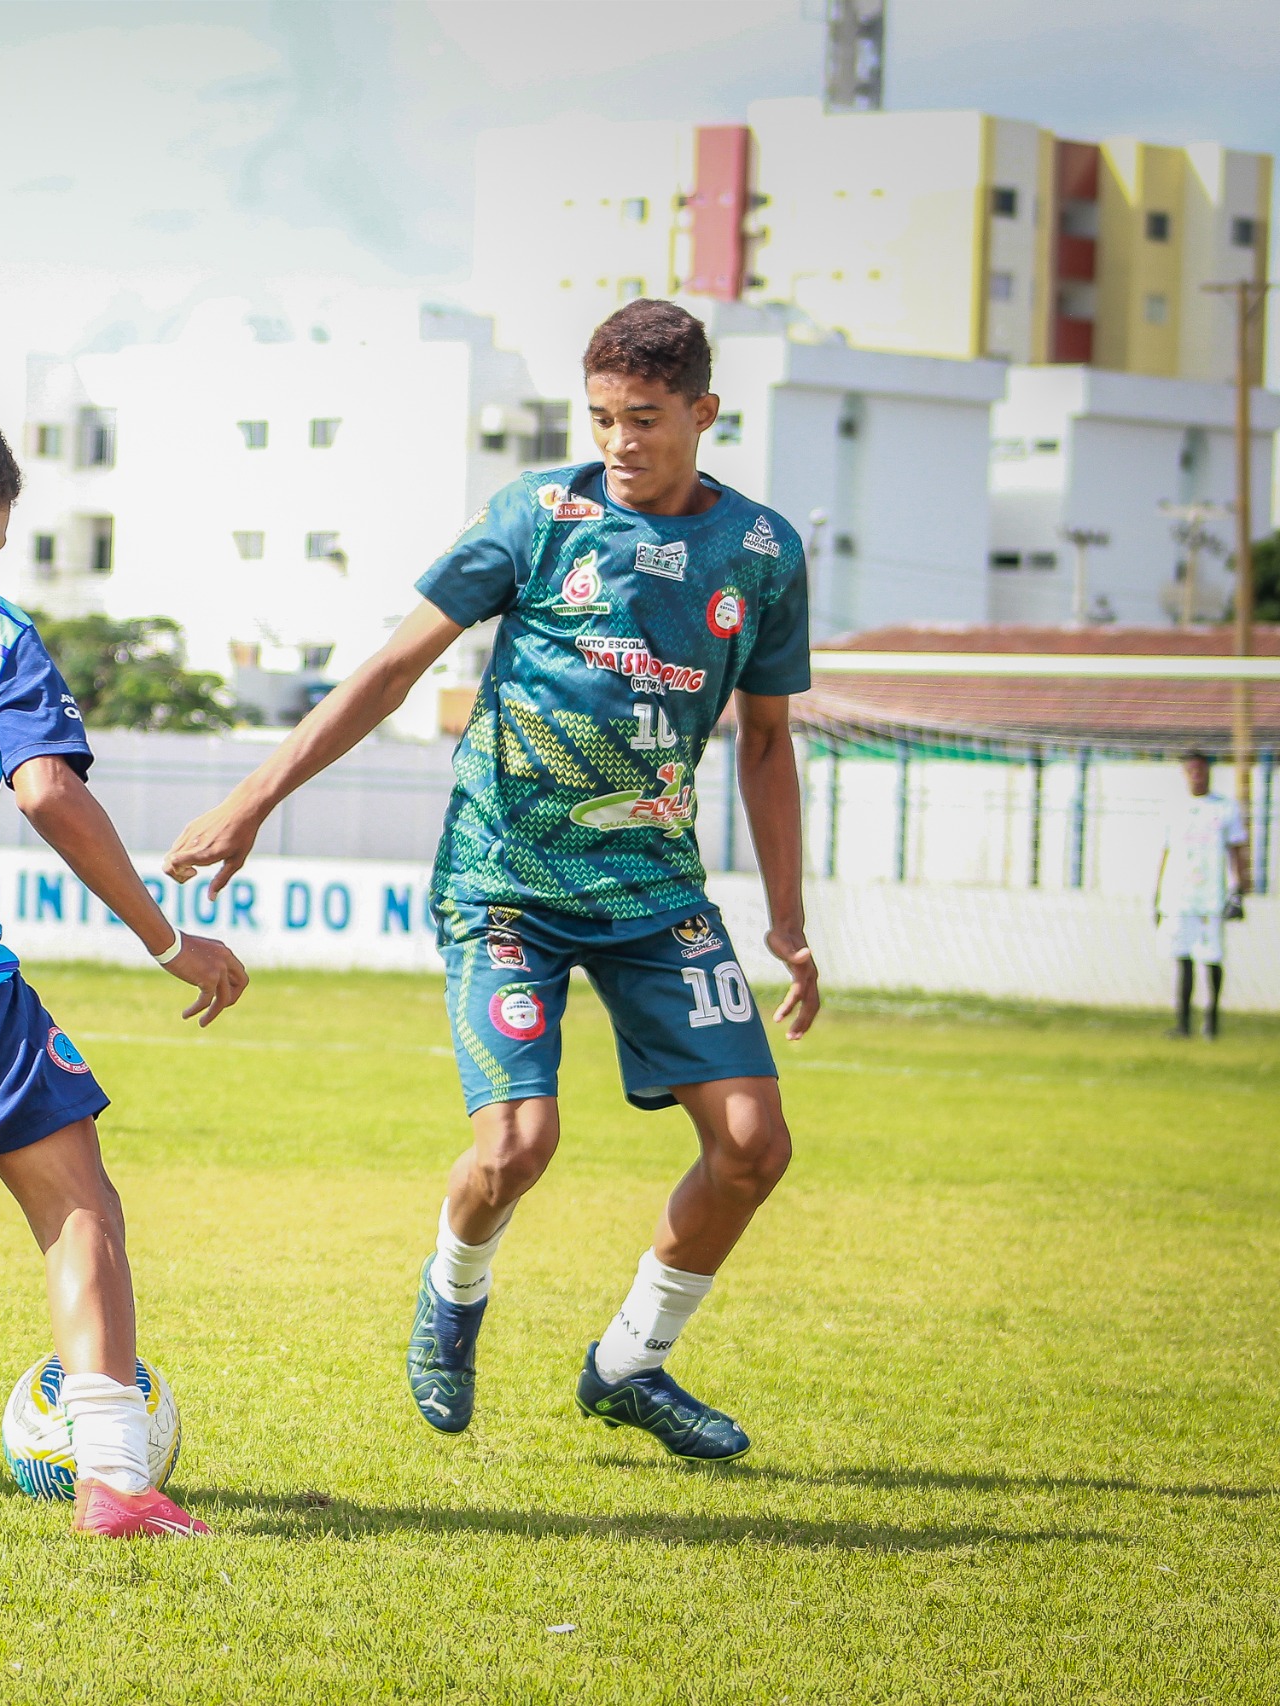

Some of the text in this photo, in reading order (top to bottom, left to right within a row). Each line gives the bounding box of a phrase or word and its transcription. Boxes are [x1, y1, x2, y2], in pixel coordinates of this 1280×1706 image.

[577, 639, 647, 649] AUTO ESCOLA
[629, 786, 690, 817] POLI
[16, 869, 258, 928] INTIOR
[285, 879, 351, 931] DO
[681, 961, 752, 1028] 10
